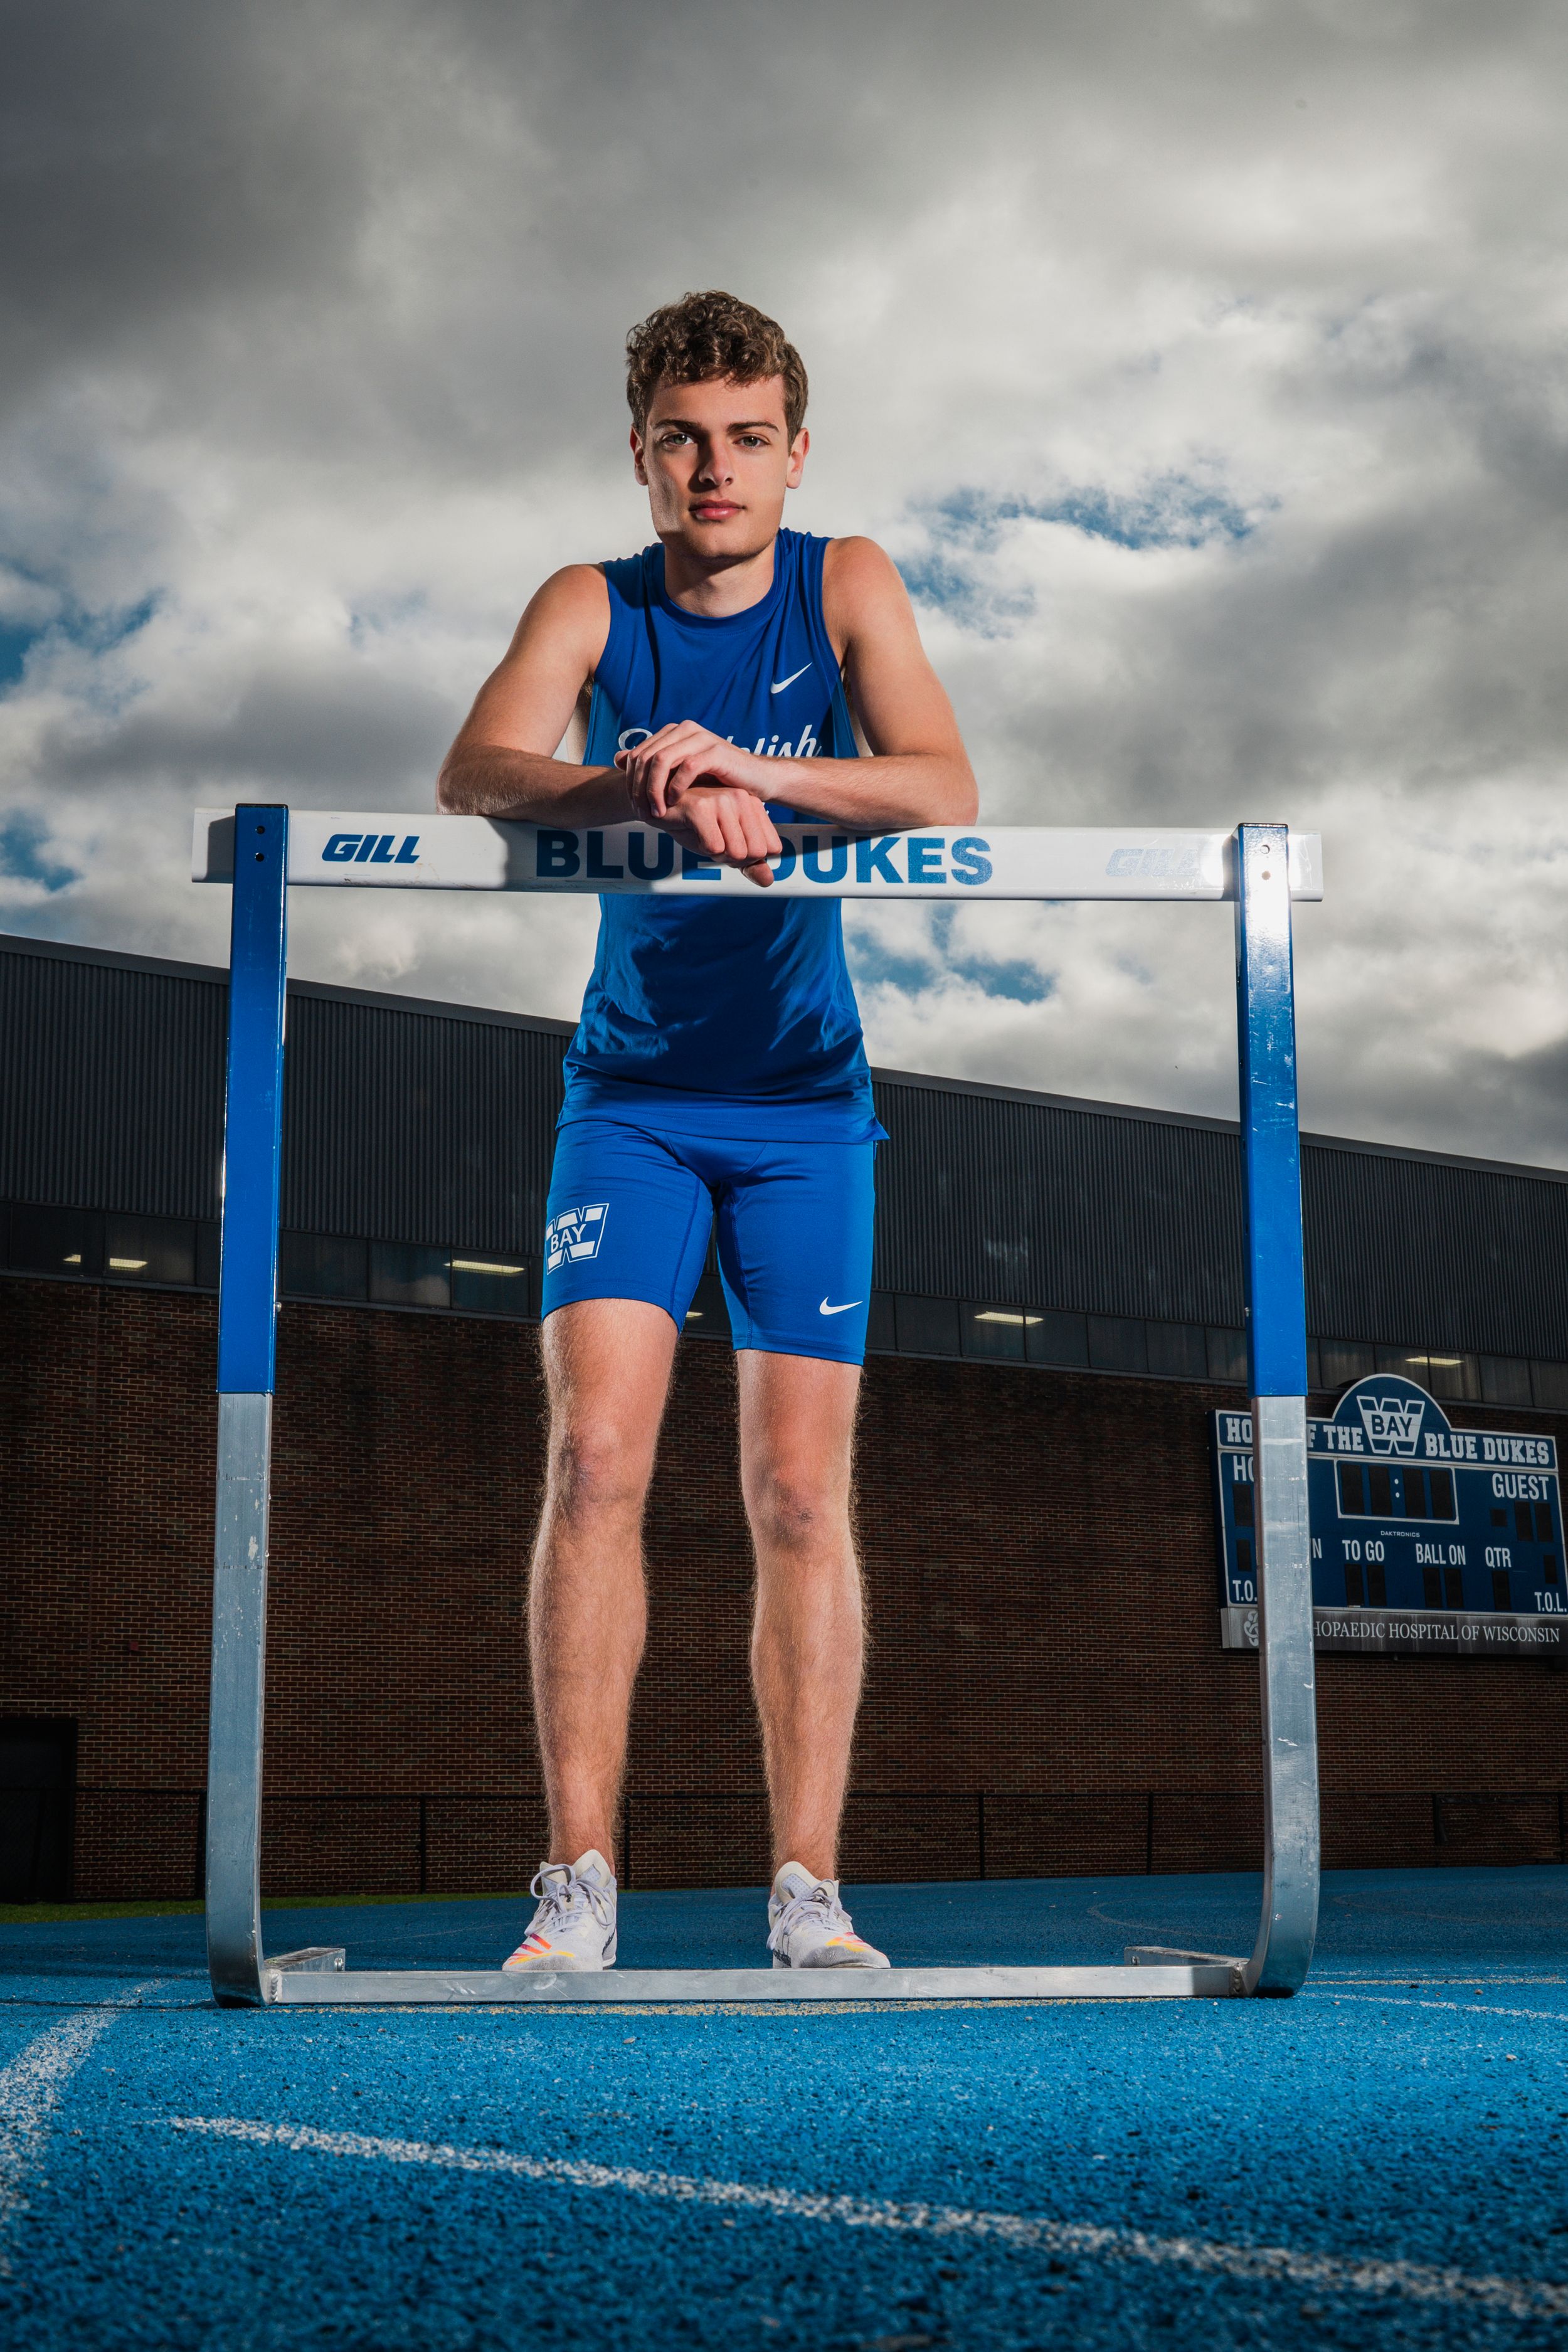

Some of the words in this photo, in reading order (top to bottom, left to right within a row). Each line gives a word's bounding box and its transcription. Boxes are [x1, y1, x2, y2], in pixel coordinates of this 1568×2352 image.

[322, 834, 420, 864] GILL
[536, 829, 722, 881] BLUE
[551, 1224, 587, 1254] BAY
[1372, 1414, 1412, 1437] BAY
[1226, 1417, 1253, 1443] HO
[1306, 1424, 1316, 1448] F
[1323, 1426, 1364, 1451] THE
[1425, 1433, 1477, 1459] BLUE
[1483, 1438, 1549, 1464] DUKES
[1493, 1473, 1549, 1500] GUEST
[1342, 1540, 1360, 1560] TO
[1365, 1541, 1384, 1561] GO
[1416, 1544, 1446, 1564] BALL
[1449, 1545, 1466, 1565] ON
[1485, 1547, 1511, 1567] QTR
[1535, 1592, 1566, 1612] T.O.L.
[1313, 1621, 1385, 1638] HOPAEDIC
[1389, 1623, 1458, 1639] HOSPITAL
[1462, 1626, 1479, 1640] OF
[1483, 1626, 1559, 1642] WISCONSIN
